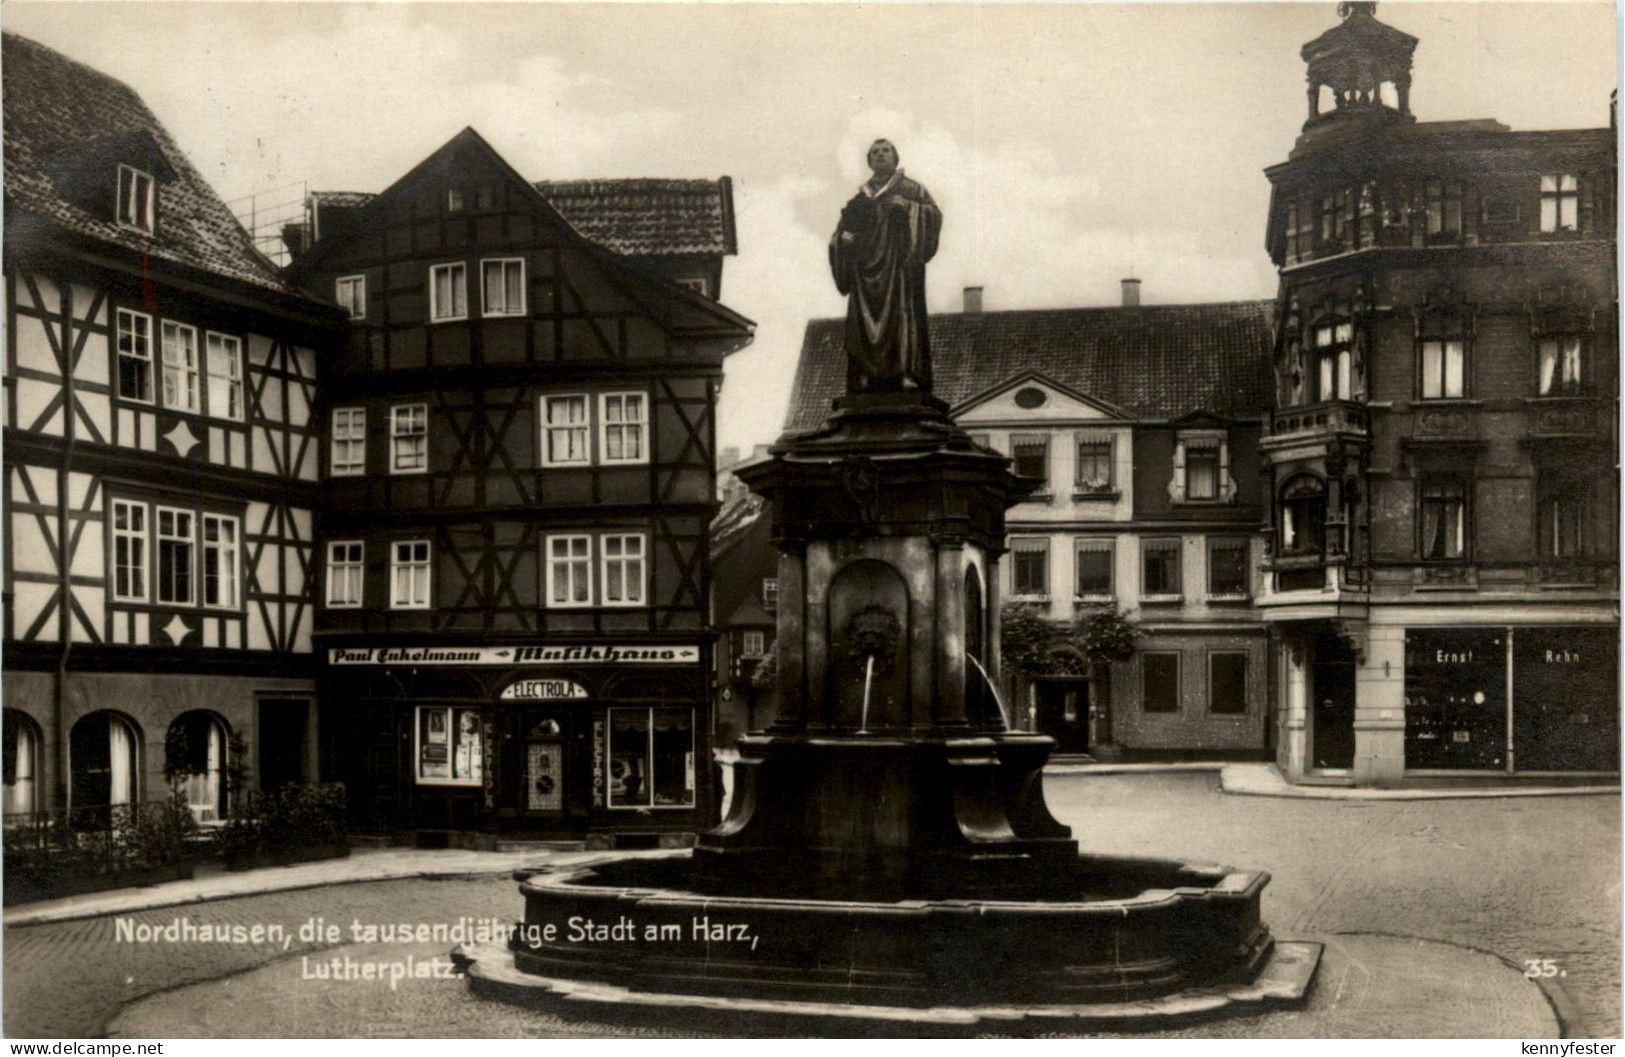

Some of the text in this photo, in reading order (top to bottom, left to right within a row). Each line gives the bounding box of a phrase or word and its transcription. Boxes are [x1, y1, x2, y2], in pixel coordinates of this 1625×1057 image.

[334, 648, 373, 662] Paul
[1436, 650, 1580, 663] Ernst Rehn
[514, 681, 575, 698] ELECTROLA
